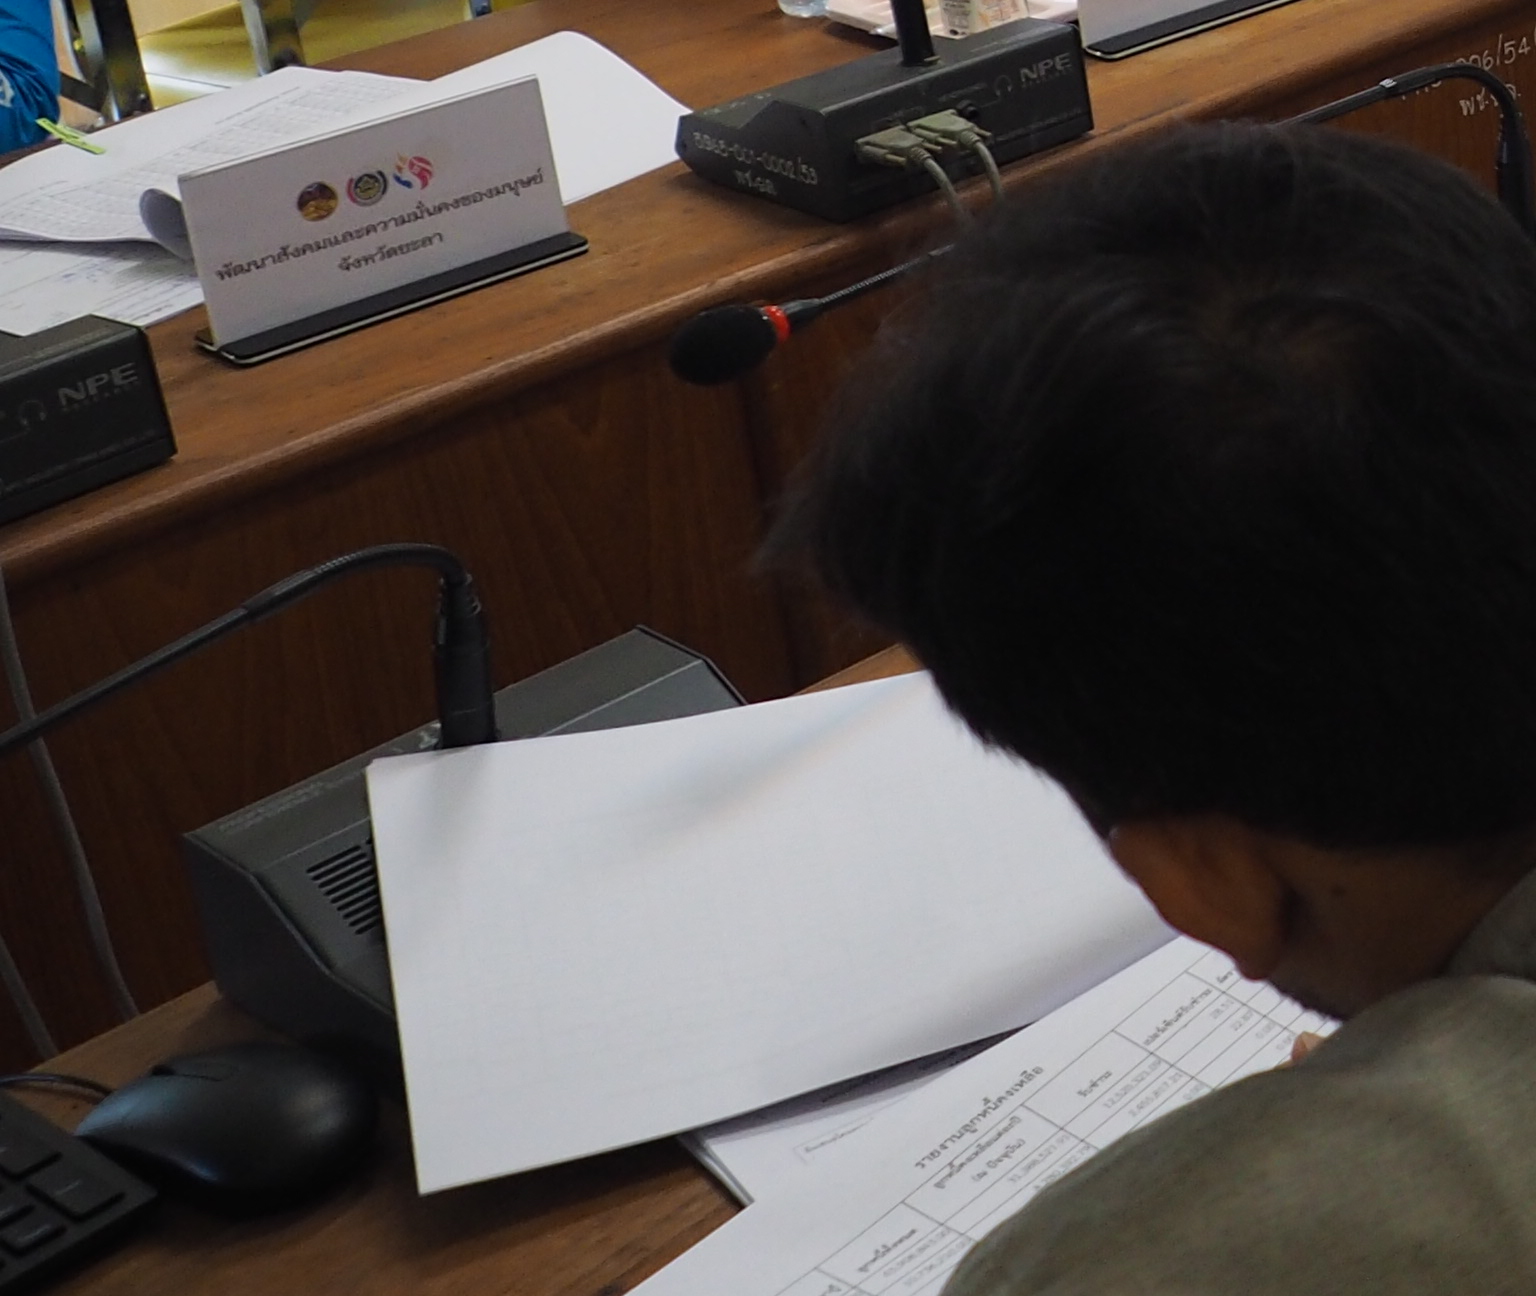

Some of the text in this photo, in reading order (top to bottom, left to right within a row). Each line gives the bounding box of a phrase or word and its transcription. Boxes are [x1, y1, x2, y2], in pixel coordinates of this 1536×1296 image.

[1019, 52, 1072, 82] NPE
[215, 167, 546, 282] พัฒนาสังคมและความมั่นคงของมนุษย์
[337, 230, 444, 273] จังหวัดยะลา
[57, 362, 139, 406] NPE
[914, 1065, 1044, 1169] รายงานลูกหนี้คงเหลือ
